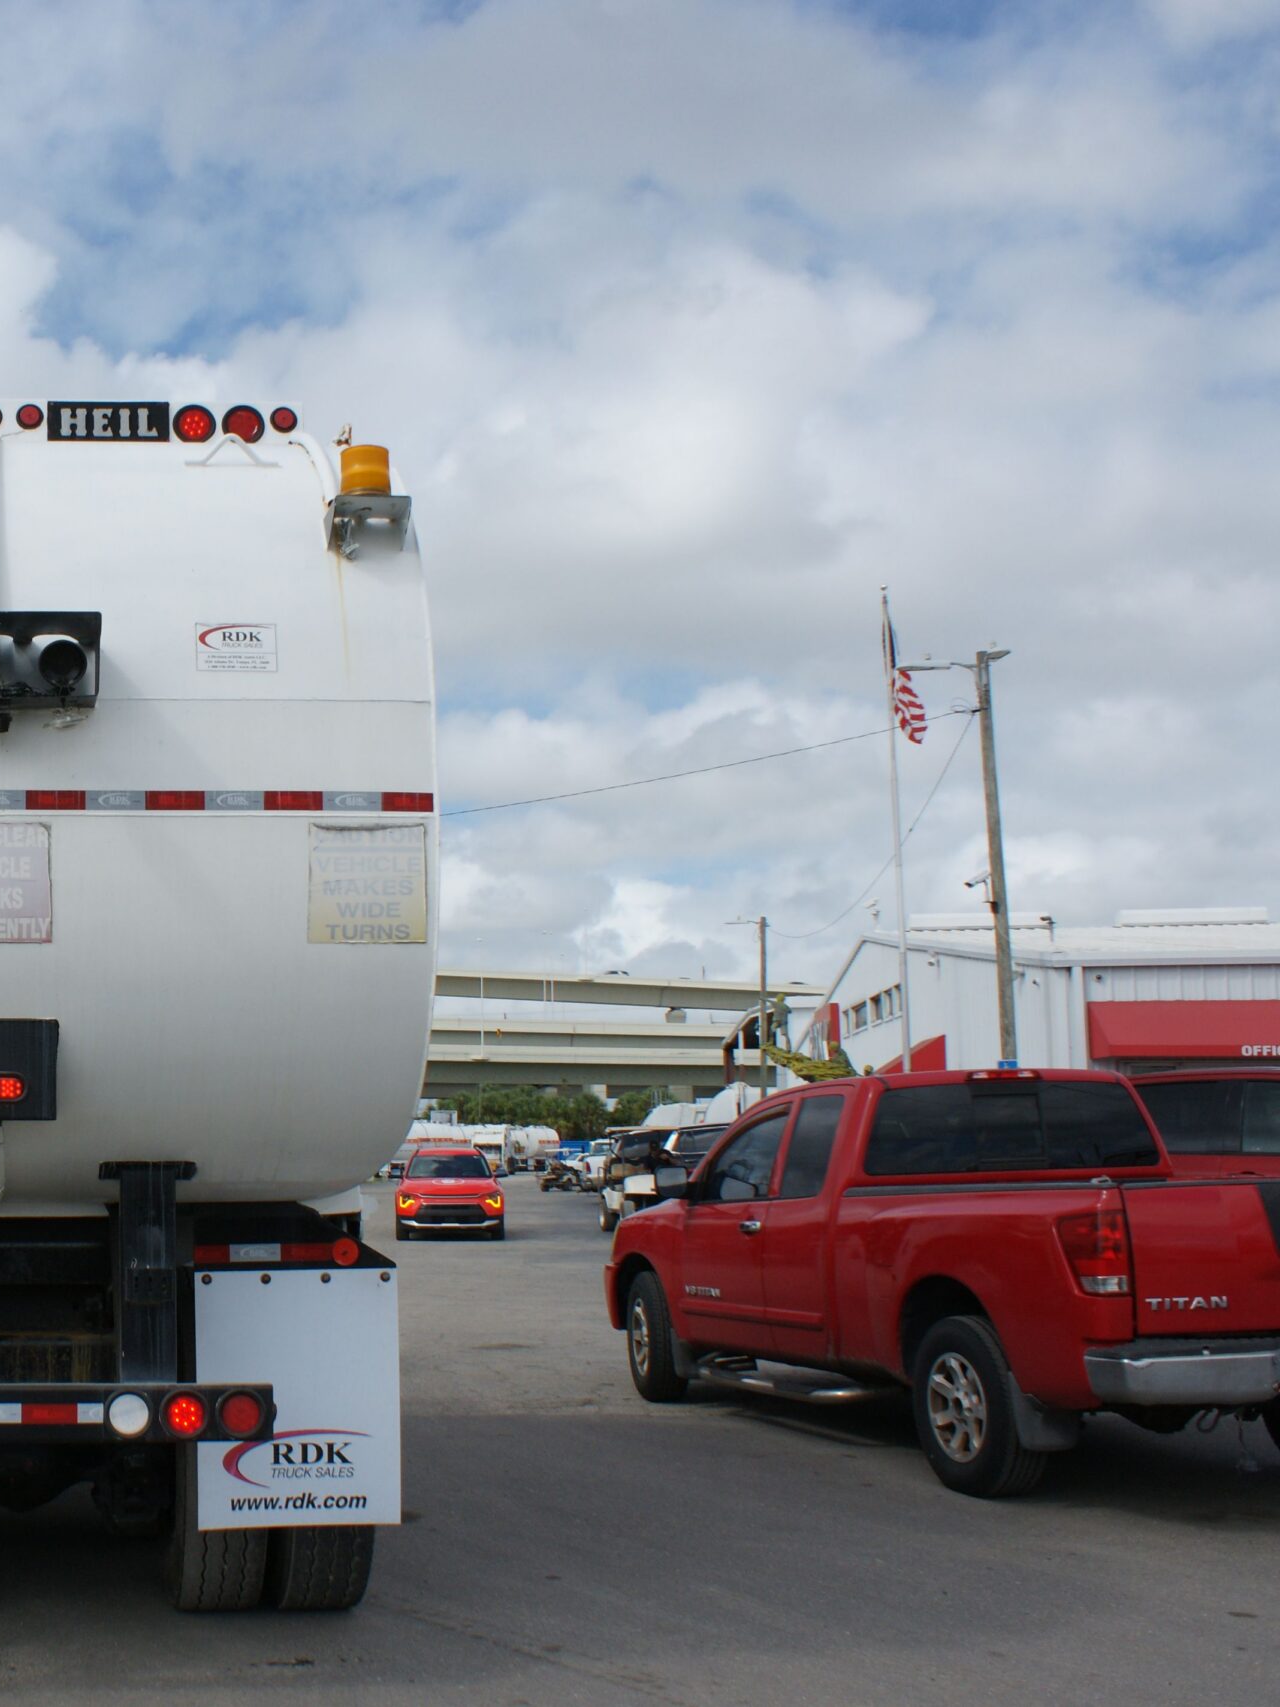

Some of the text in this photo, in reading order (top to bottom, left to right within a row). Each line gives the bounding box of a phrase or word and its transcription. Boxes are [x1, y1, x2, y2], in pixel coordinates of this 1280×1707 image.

[60, 407, 159, 437] HEIL
[222, 631, 262, 642] RDK
[317, 856, 422, 873] VEHICLE
[323, 879, 414, 896] MAKES
[336, 902, 402, 918] WIDE
[326, 924, 411, 940] TURNS
[1145, 1296, 1228, 1311] TITAN
[271, 1442, 354, 1465] RDK
[271, 1467, 355, 1479] TRUCK SALES
[231, 1493, 367, 1511] www.rdk.com
